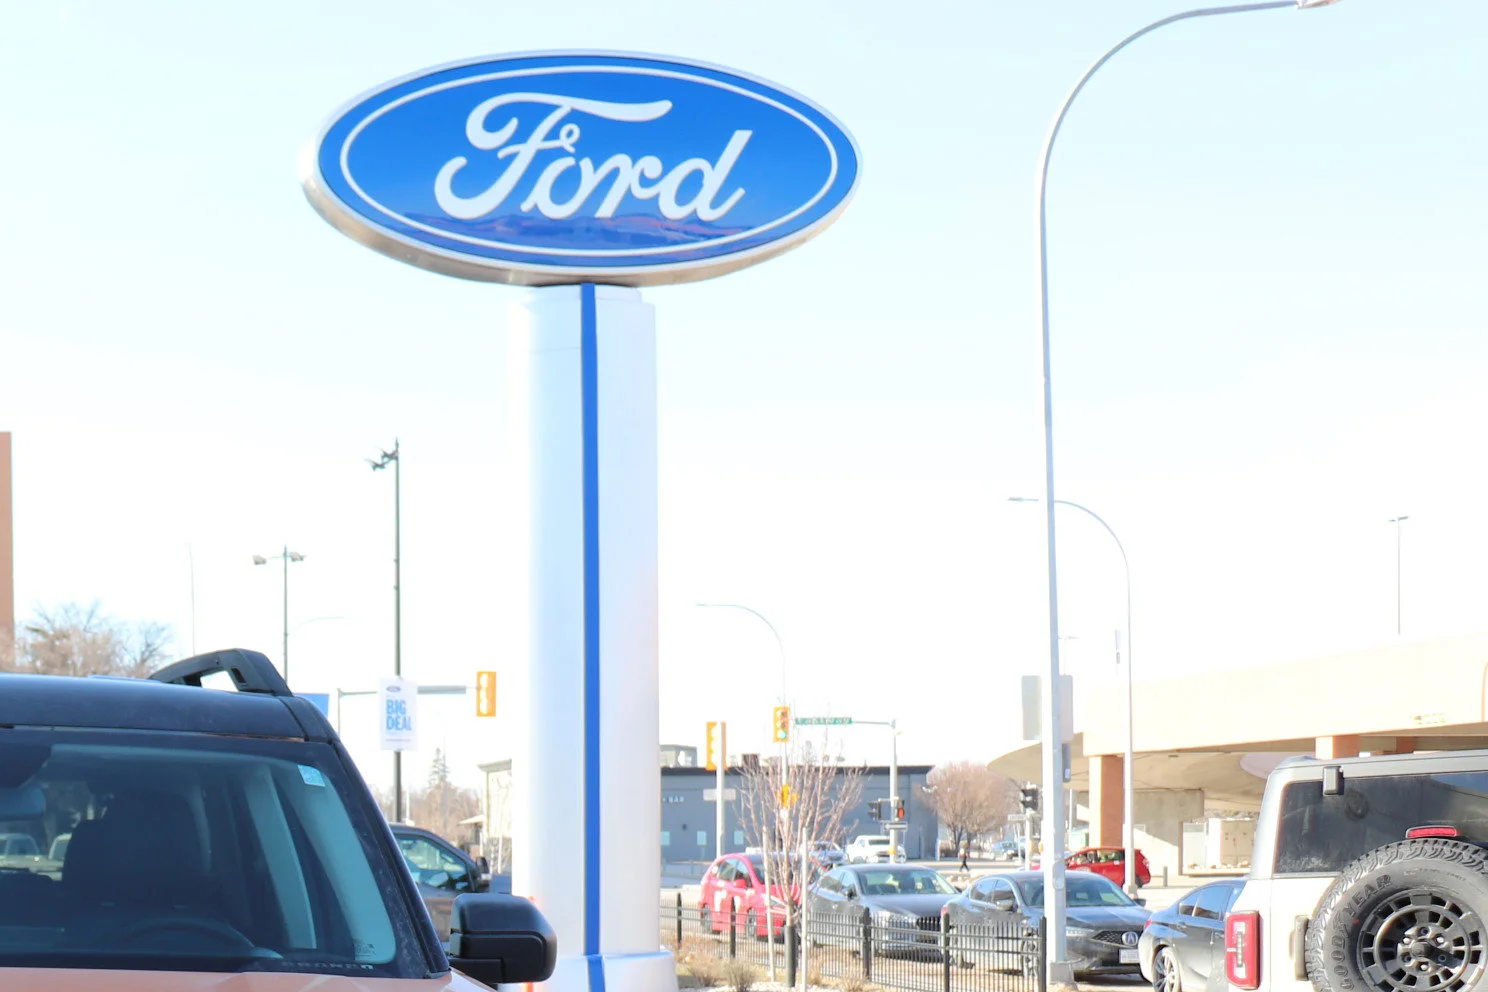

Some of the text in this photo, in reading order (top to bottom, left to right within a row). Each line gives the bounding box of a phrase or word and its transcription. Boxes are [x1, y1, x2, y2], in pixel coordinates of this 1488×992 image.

[434, 91, 753, 222] Ford
[386, 699, 407, 715] BIG
[386, 715, 412, 731] DEAL
